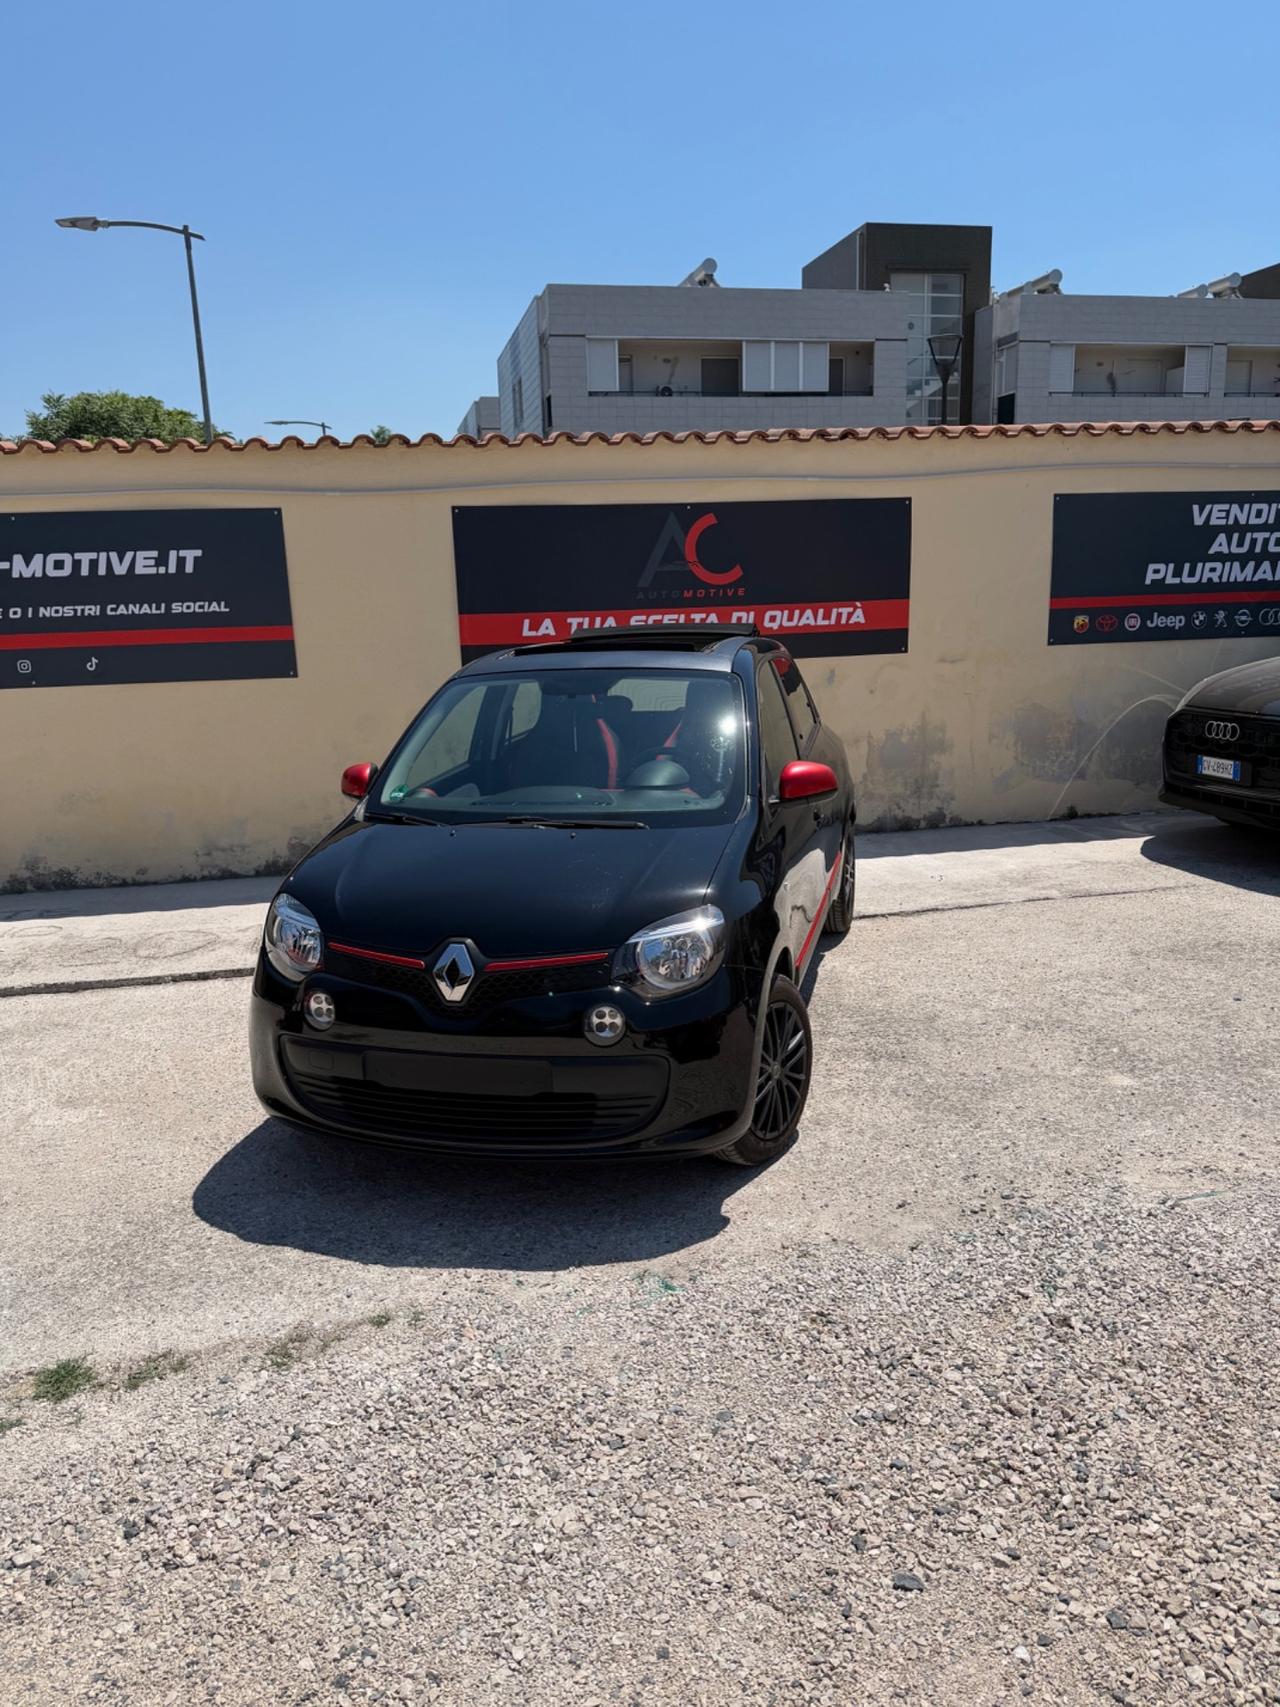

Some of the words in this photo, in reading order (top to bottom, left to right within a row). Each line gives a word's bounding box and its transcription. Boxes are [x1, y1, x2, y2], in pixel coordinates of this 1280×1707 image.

[1192, 503, 1280, 526] VENDI
[1145, 562, 1280, 585] PLURIMA
[636, 587, 745, 600] AUTOMOTIVE
[9, 607, 22, 618] O
[28, 607, 33, 618] I
[39, 605, 100, 618] NOSTRI
[106, 603, 165, 616] CANALI
[171, 601, 230, 613] SOCIAL
[522, 618, 556, 637] LA
[567, 616, 617, 635] TUA
[763, 602, 865, 630] QUALITÀ
[1147, 612, 1185, 630] Jeep
